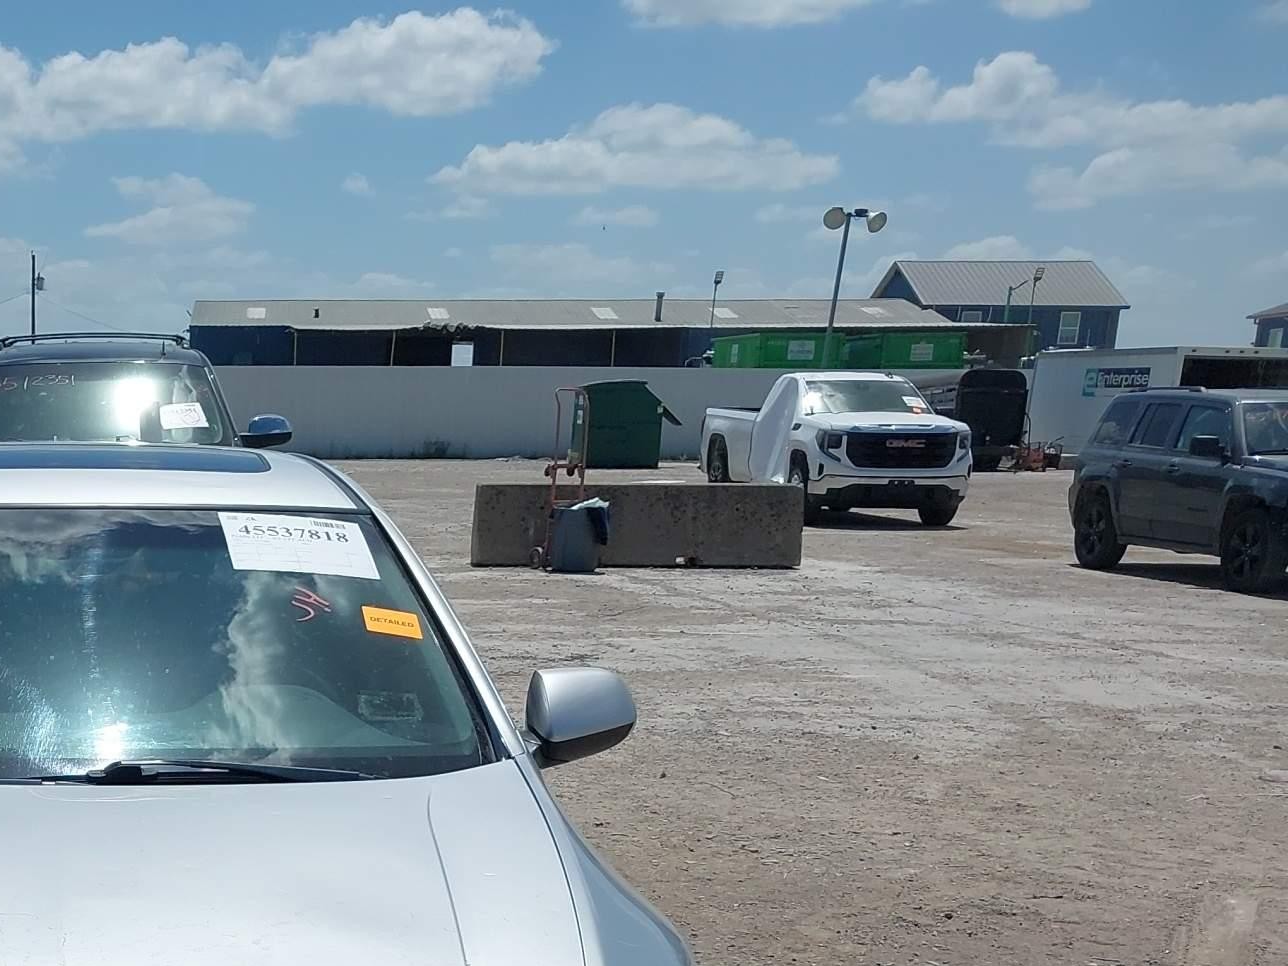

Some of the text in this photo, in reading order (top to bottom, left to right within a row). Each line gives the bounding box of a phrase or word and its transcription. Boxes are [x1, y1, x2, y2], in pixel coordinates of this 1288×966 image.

[1097, 370, 1150, 388] Enterprise
[886, 439, 927, 448] GMC
[238, 524, 350, 544] 45537818
[369, 616, 415, 628] DETAILED
